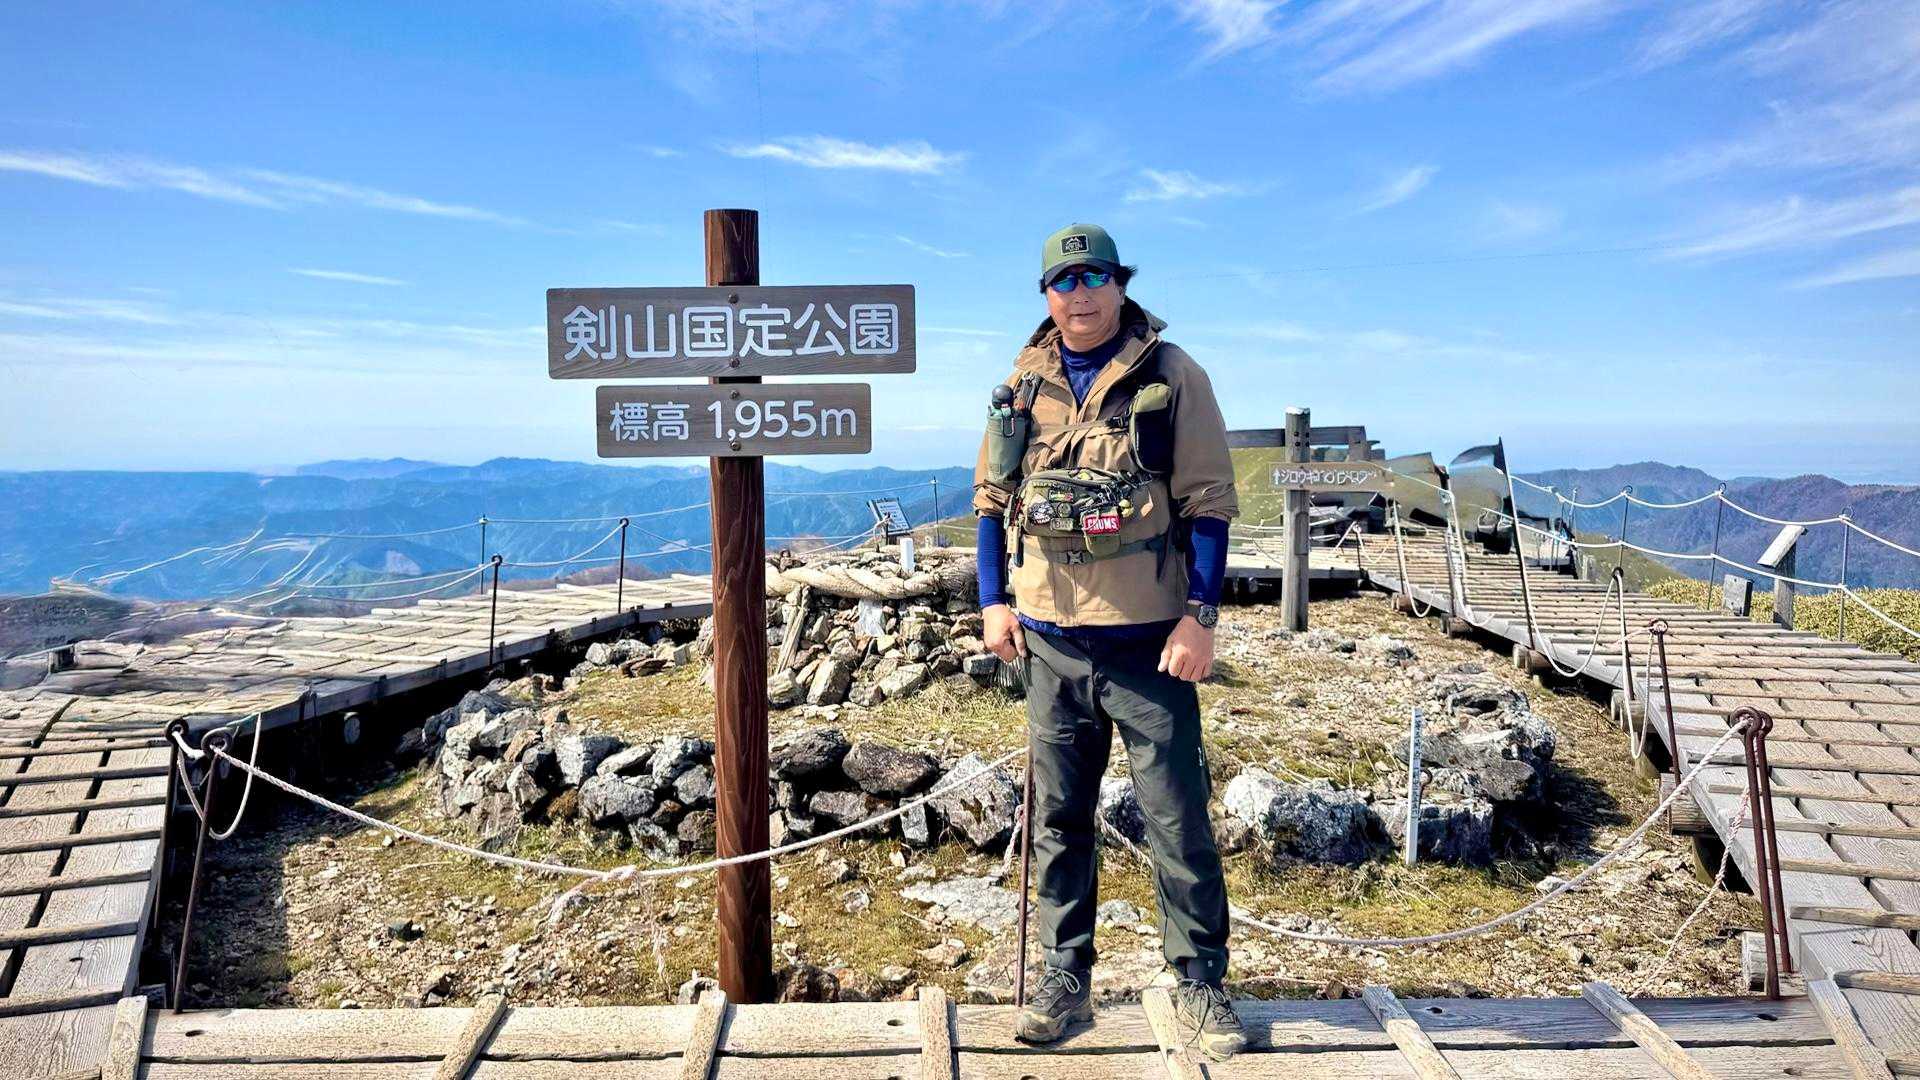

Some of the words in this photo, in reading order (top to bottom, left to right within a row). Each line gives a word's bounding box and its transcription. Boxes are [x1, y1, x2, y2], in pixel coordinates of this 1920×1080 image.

[562, 302, 899, 361] 剣山国定公園
[609, 401, 690, 441] 標高
[706, 399, 857, 441] 1,955m
